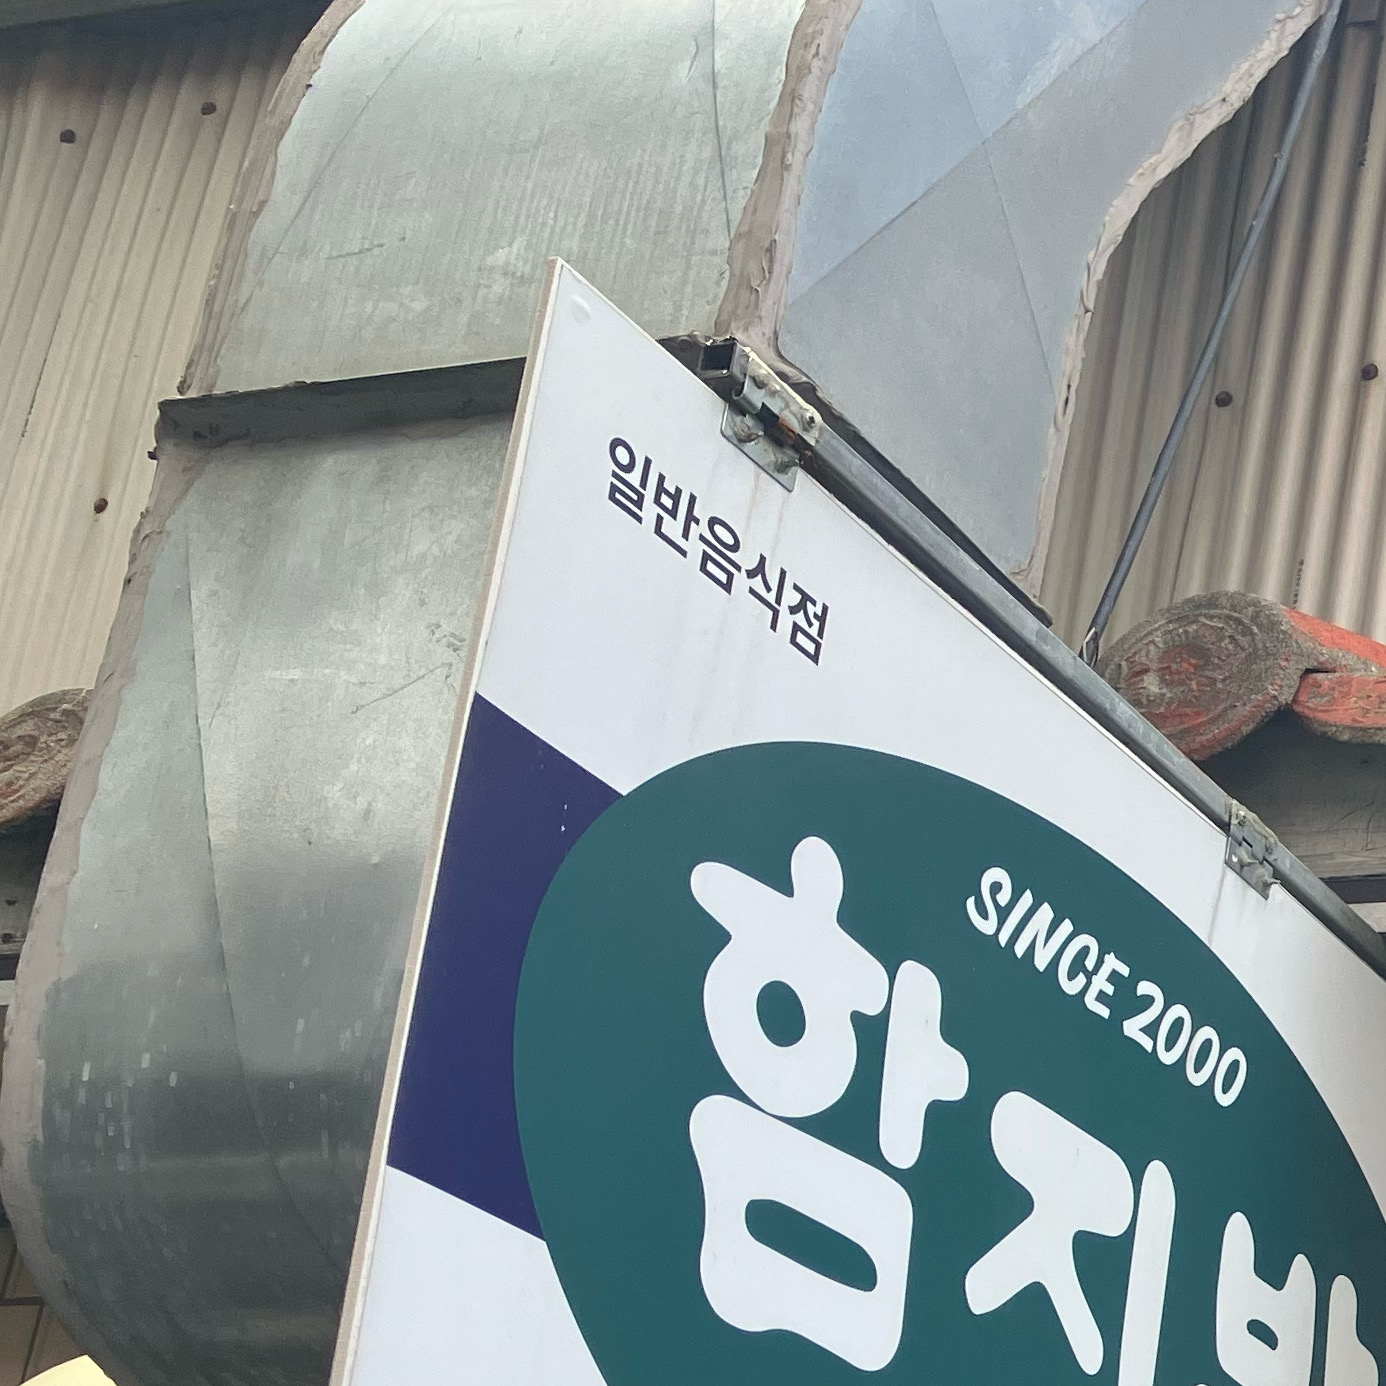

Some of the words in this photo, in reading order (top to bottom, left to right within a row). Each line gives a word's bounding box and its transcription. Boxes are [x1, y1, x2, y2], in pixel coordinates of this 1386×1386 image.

[607, 436, 829, 666] 일반음식점
[966, 867, 1129, 1019] SINCE
[1122, 980, 1247, 1107] 2000
